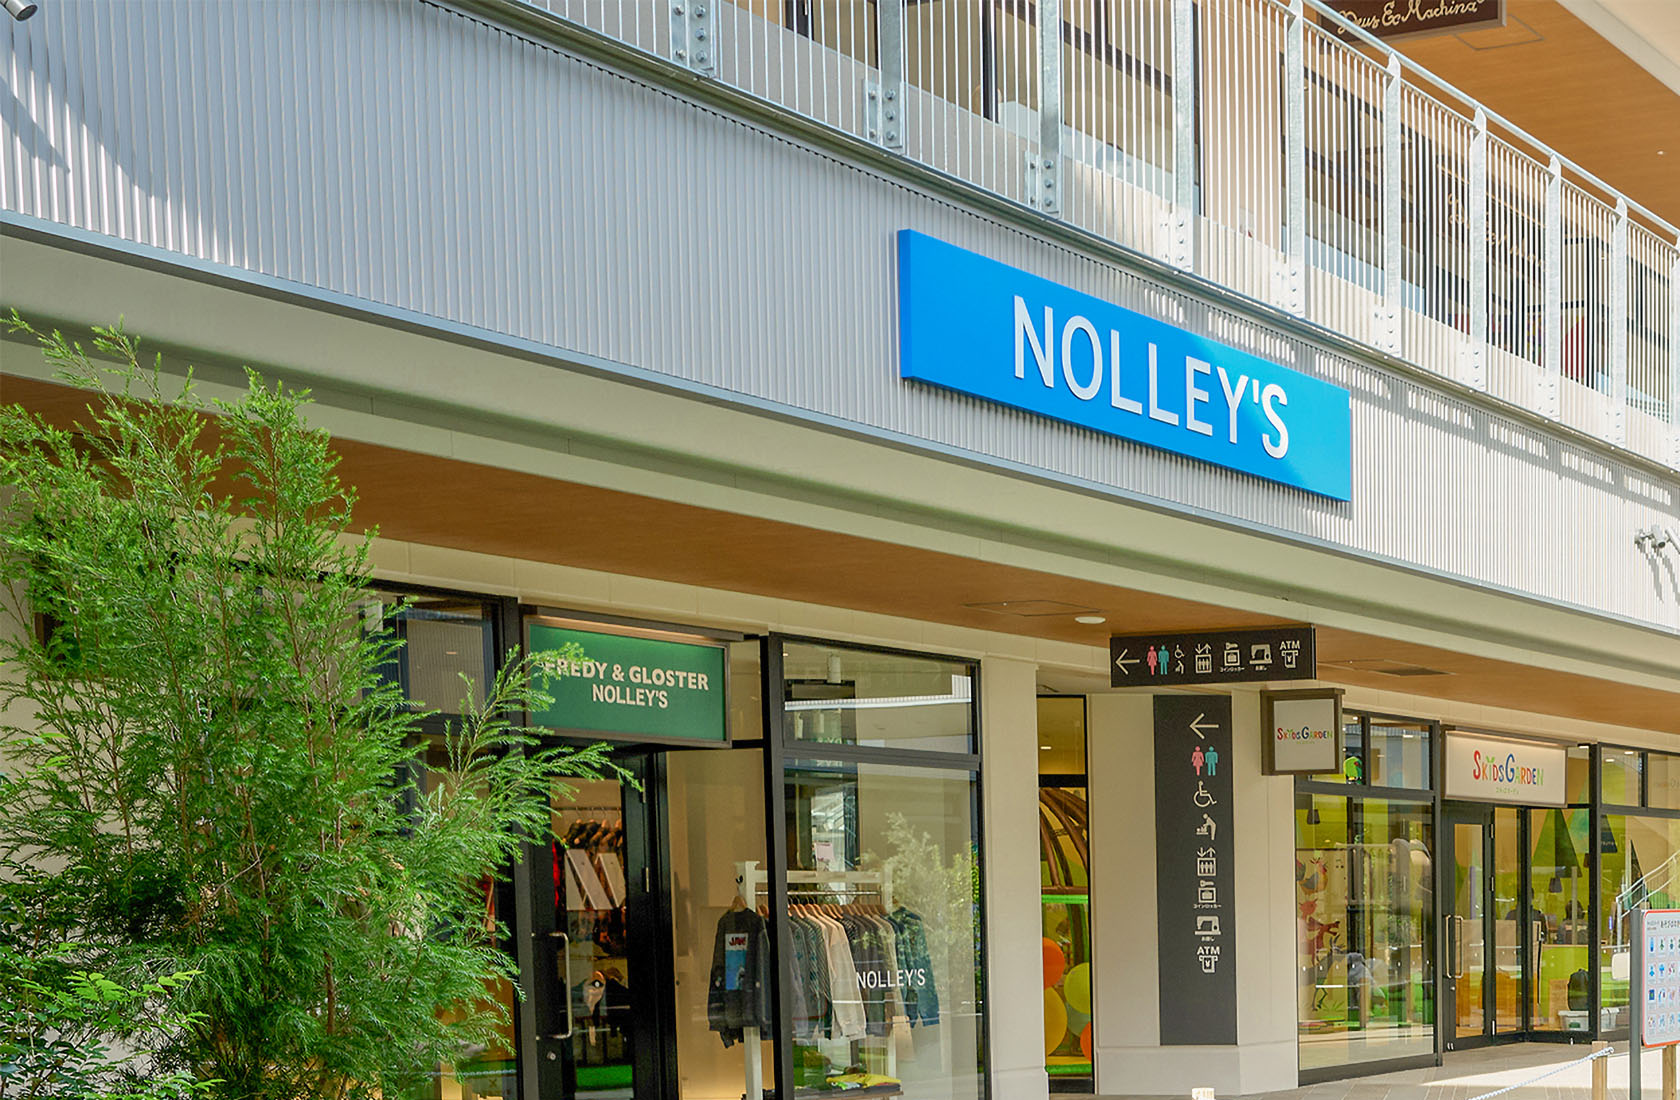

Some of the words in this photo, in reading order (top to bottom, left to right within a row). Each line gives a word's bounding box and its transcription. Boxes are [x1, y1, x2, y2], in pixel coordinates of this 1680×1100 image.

[1013, 294, 1289, 460] NOLLEY'S
[1279, 640, 1301, 650] ATM
[612, 664, 625, 682] &
[629, 665, 709, 691] GLOSTER
[592, 683, 669, 709] NOLLEY'S
[1196, 945, 1220, 956] ATM
[855, 967, 926, 989] NOLLEY'S
